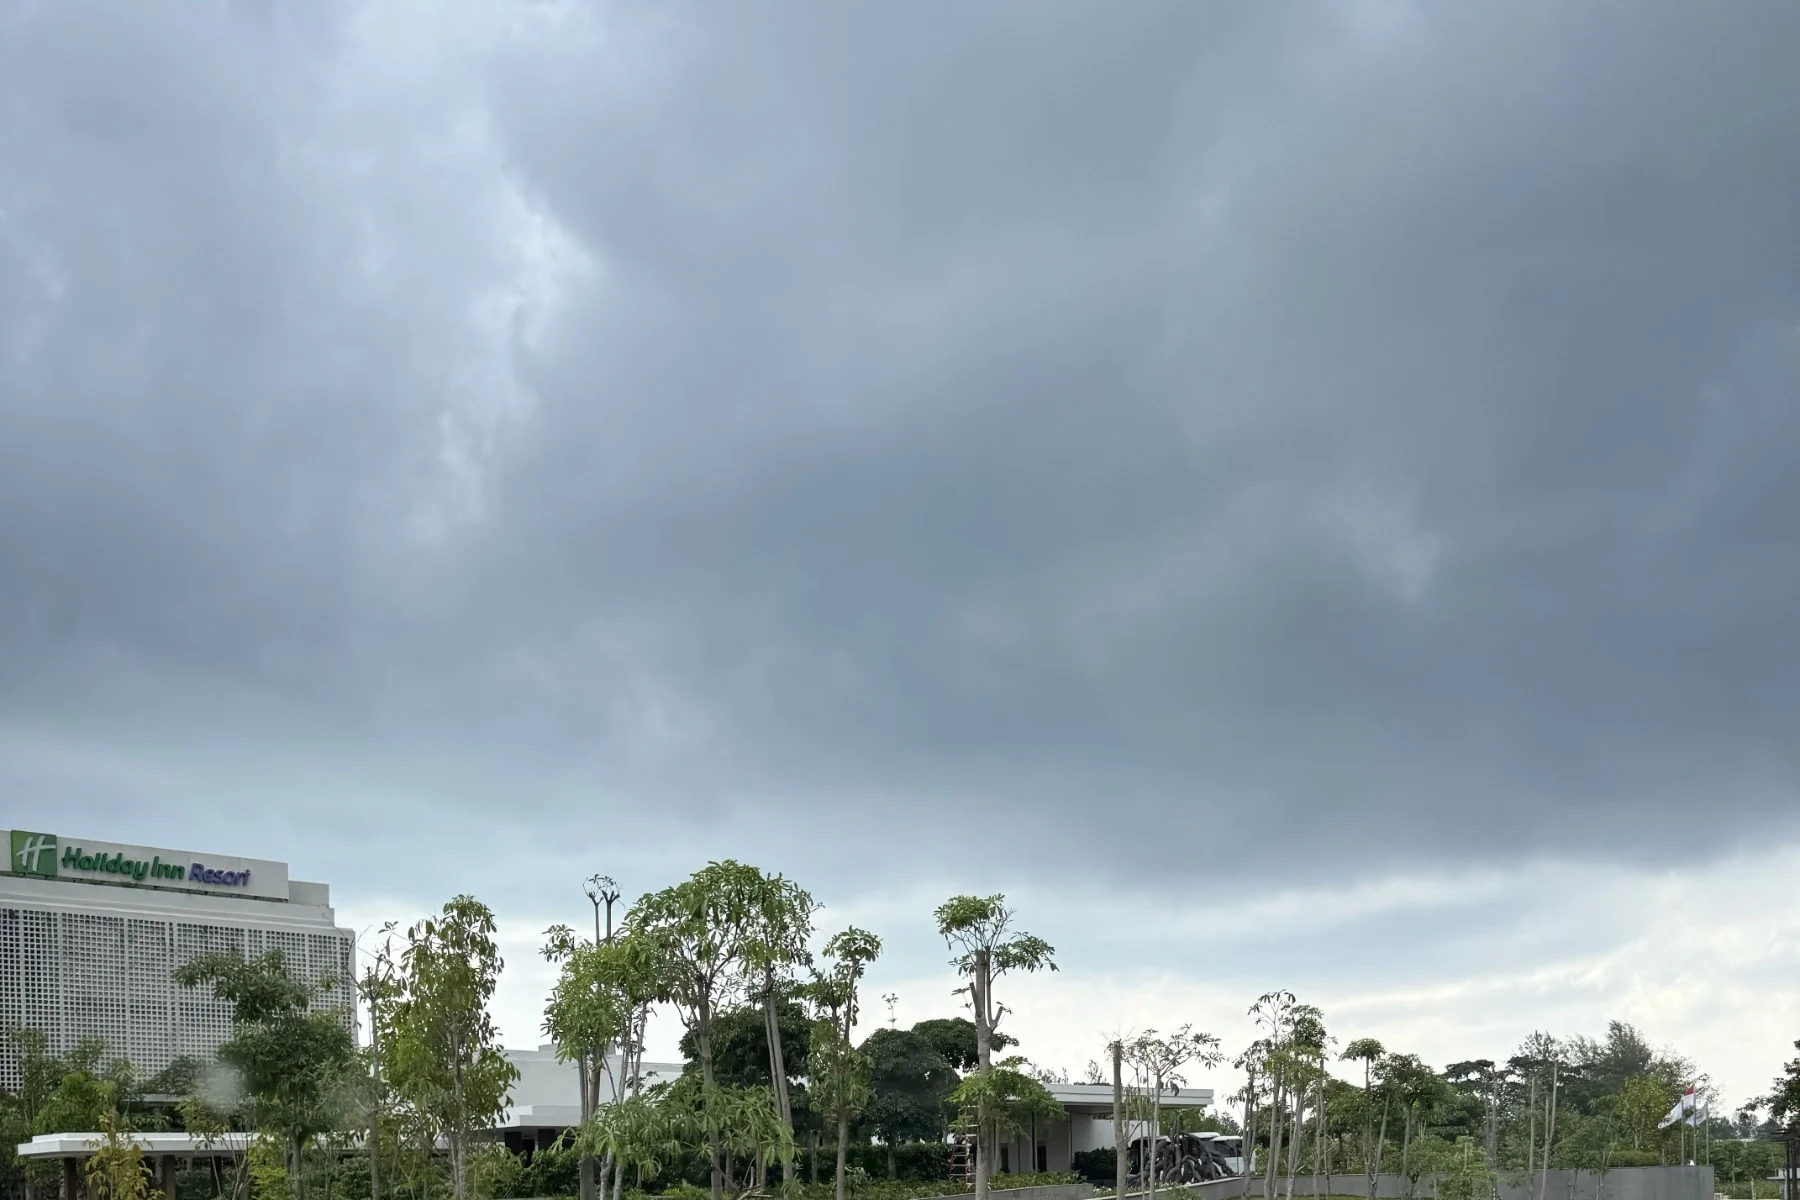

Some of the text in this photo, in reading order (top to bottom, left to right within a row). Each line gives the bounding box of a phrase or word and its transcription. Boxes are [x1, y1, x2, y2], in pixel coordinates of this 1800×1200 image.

[61, 846, 251, 887] Holiday Inn Resort
